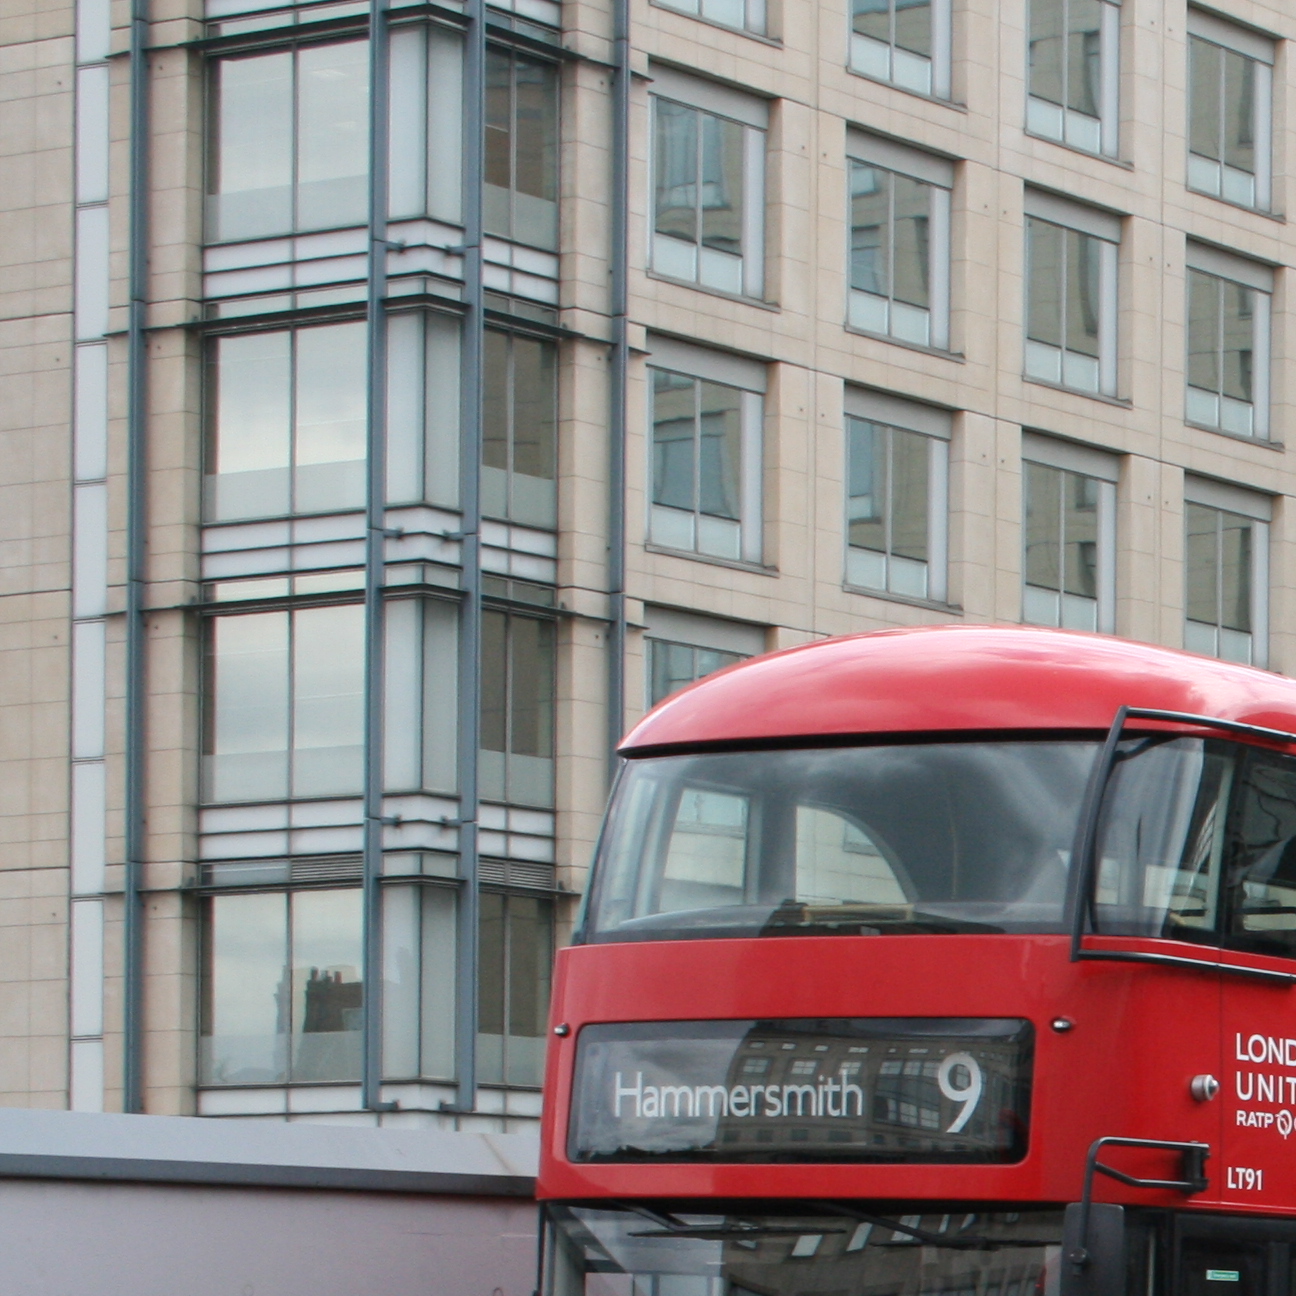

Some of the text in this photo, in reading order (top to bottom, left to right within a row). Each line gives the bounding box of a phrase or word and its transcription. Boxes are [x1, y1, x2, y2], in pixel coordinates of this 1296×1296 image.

[614, 1052, 982, 1134] Hammersmith 9
[1236, 1110, 1274, 1128] RATP
[1227, 1167, 1262, 1191] LT91
